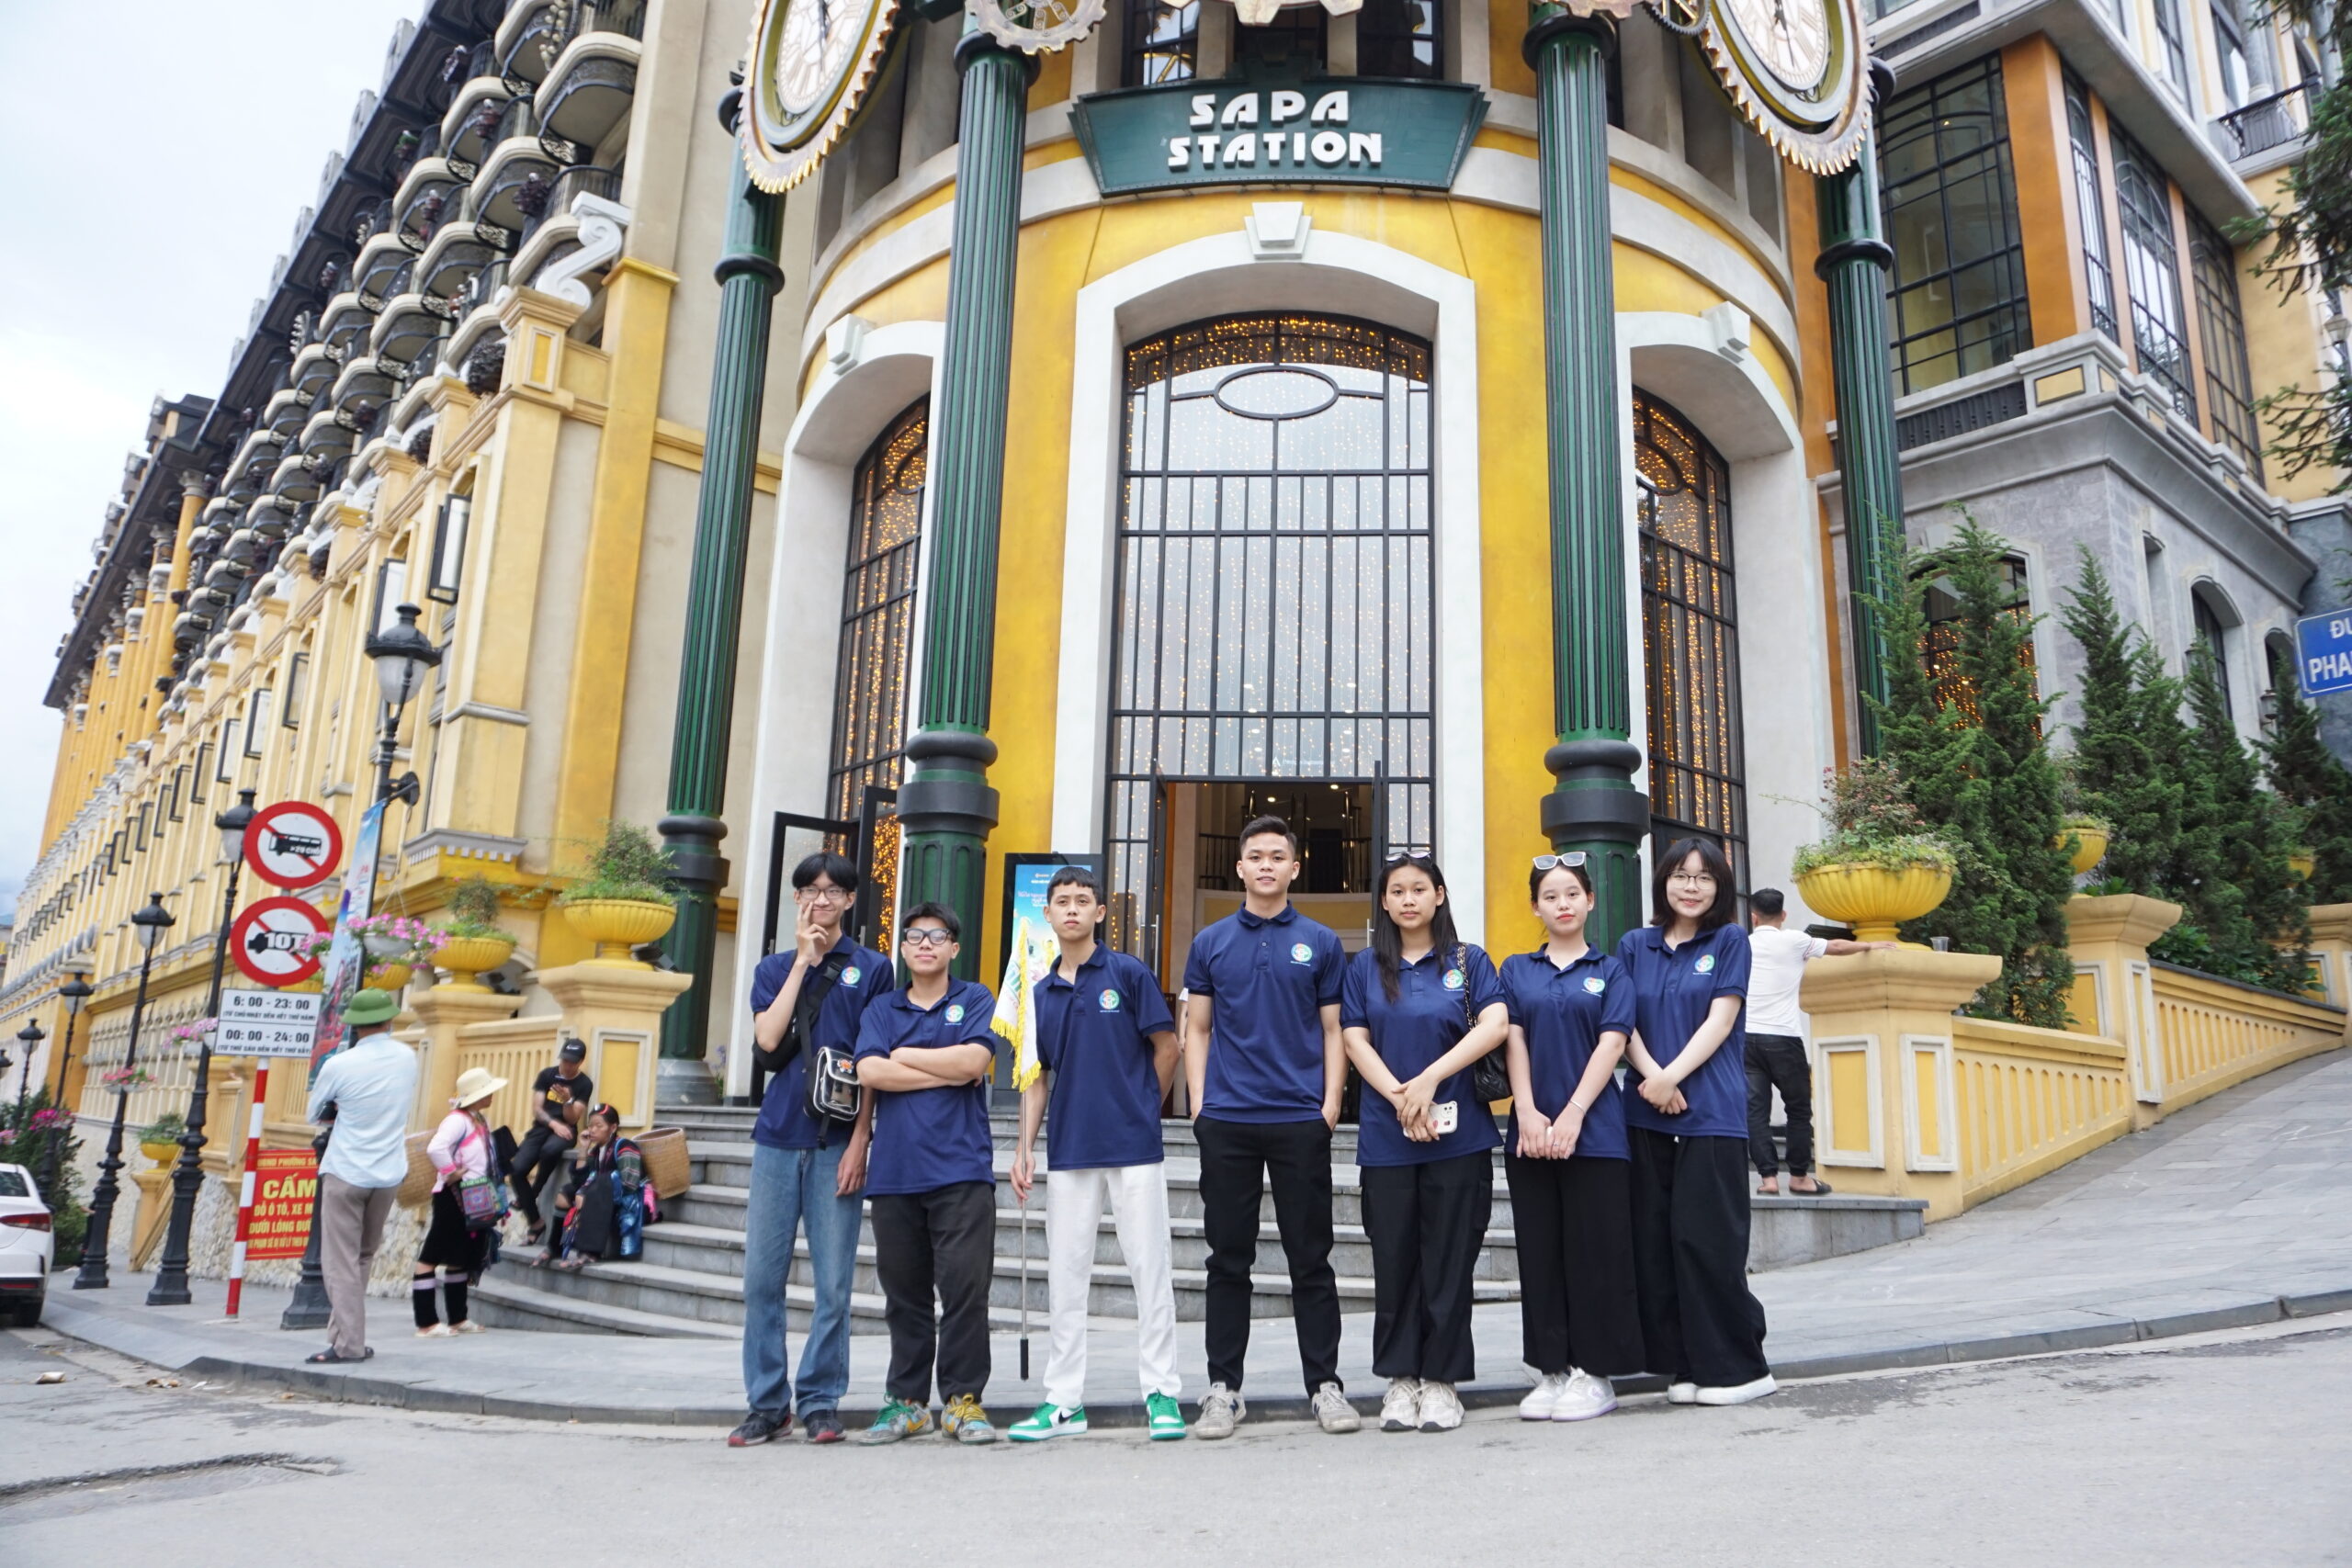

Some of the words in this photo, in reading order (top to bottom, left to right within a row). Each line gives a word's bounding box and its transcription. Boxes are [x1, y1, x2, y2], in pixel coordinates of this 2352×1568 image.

[1190, 90, 1349, 129] SAPA
[1168, 130, 1383, 172] STATION
[2308, 650, 2352, 683] PHA
[248, 997, 263, 1008] 00
[274, 998, 292, 1010] 23:
[295, 999, 310, 1010] 00
[226, 1029, 244, 1041] 00:
[247, 1030, 263, 1042] 00
[274, 1032, 293, 1043] 24:
[295, 1032, 310, 1043] 00
[263, 1172, 318, 1200] CẤM
